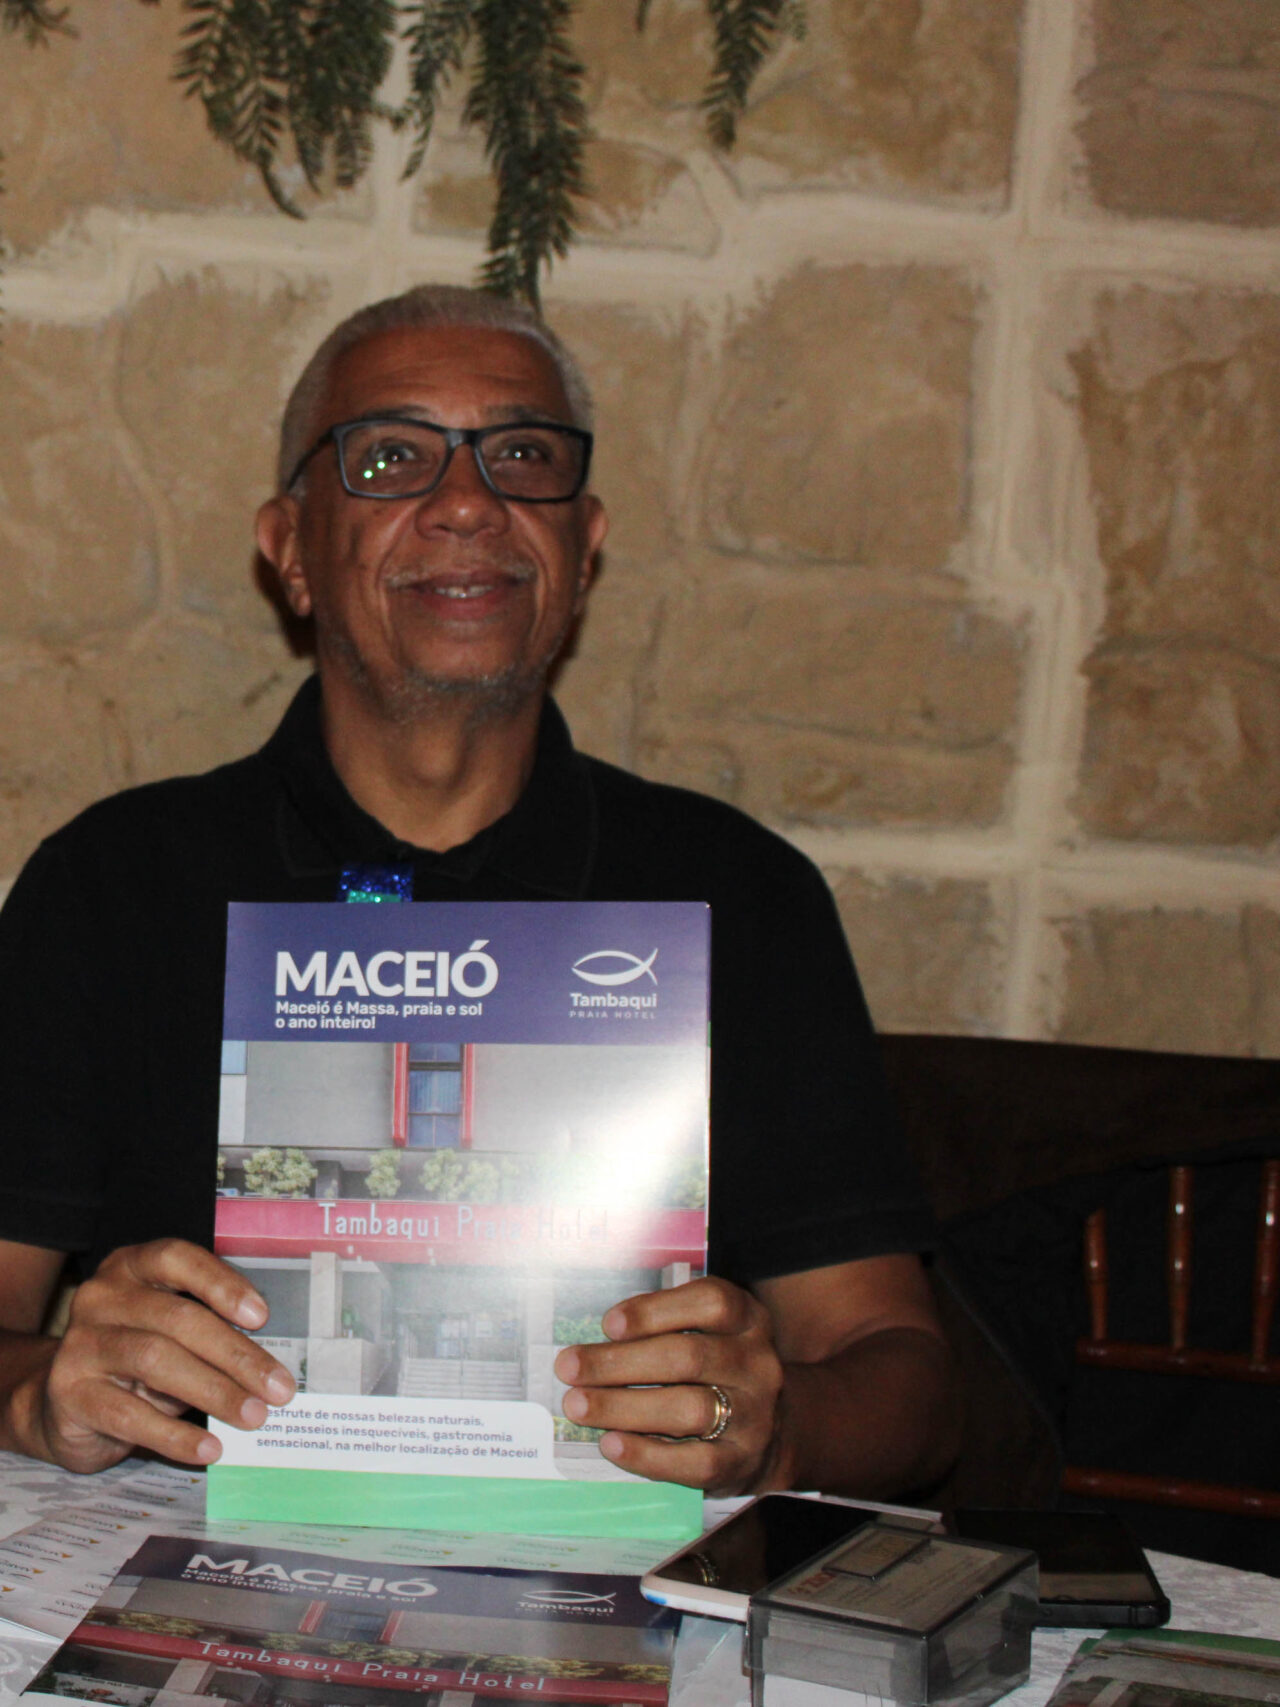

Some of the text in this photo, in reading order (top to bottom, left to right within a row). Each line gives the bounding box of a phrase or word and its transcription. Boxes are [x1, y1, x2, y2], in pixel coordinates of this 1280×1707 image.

[275, 940, 499, 998] MACEIÓ
[276, 1001, 483, 1018] Maceió é Massa, praia e sol
[569, 992, 658, 1010] Tambaqui
[275, 1016, 376, 1029] o ano inteiro!
[569, 1010, 656, 1020] PRAIA HOTEL
[318, 1202, 440, 1240] Tambaqui
[457, 1204, 522, 1241] Praia
[267, 1408, 312, 1419] esfrute
[314, 1409, 329, 1420] de
[332, 1411, 375, 1422] nossas
[378, 1412, 425, 1424] belezas
[285, 1424, 339, 1436] passeios
[433, 1430, 513, 1443] gastronomia
[335, 1441, 351, 1452] na
[353, 1442, 397, 1453] melhor
[399, 1443, 469, 1458] localização
[472, 1445, 488, 1457] de
[490, 1446, 539, 1459] Maceió!
[185, 1554, 439, 1598] MACEIÓ
[192, 1574, 228, 1585] ano
[183, 1568, 245, 1583] Maceió
[263, 1578, 322, 1594] Massa,
[327, 1587, 371, 1599] praia
[392, 1594, 417, 1603] sol
[517, 1601, 615, 1614] Tambaqui
[198, 1640, 546, 1691] Tambaqui Praia Hotel
